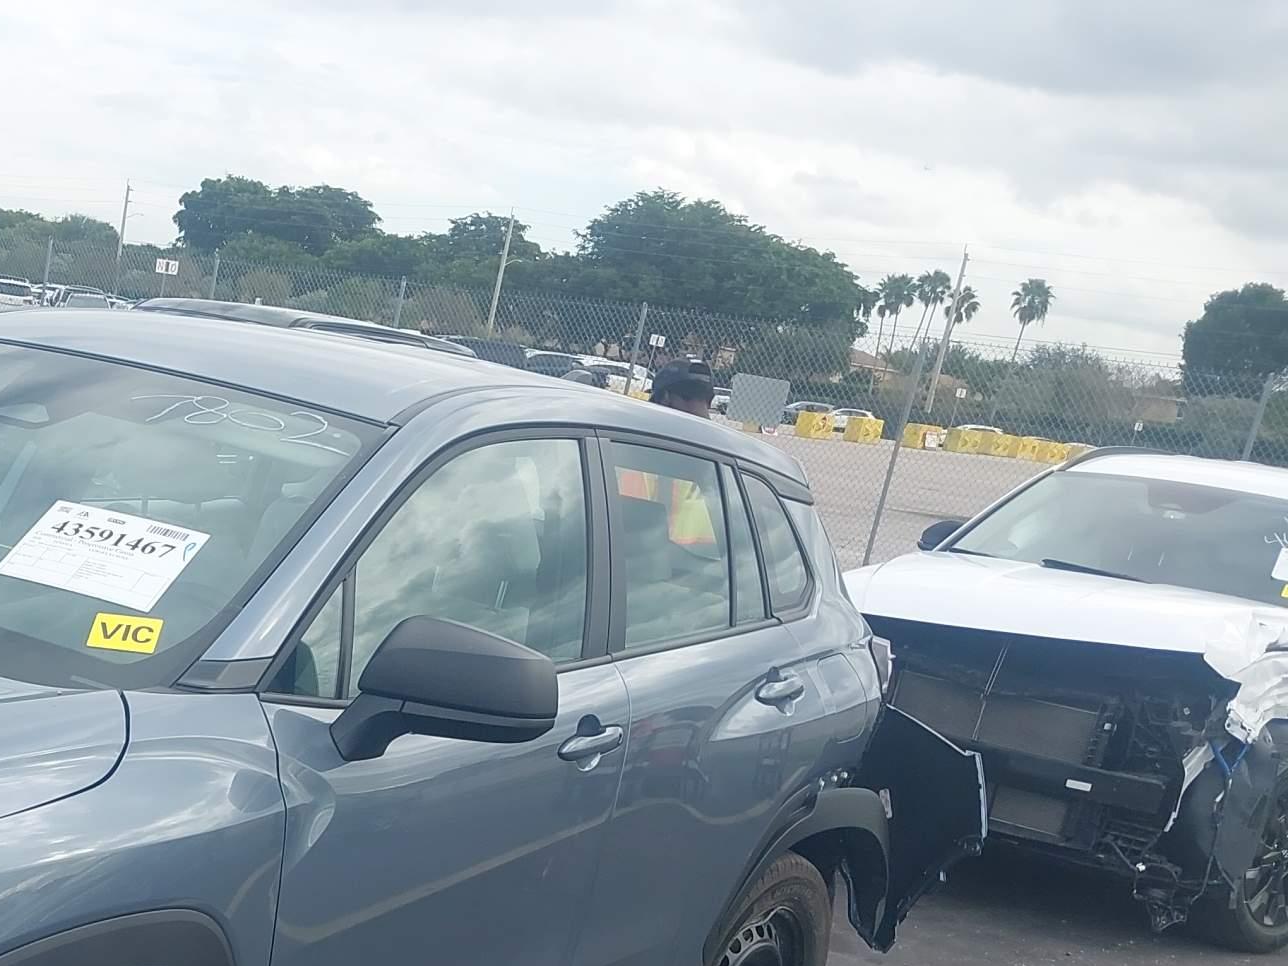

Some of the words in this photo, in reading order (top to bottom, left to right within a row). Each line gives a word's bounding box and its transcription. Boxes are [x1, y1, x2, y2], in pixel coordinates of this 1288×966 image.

[131, 394, 350, 456] 7802
[51, 520, 176, 558] 43591467
[100, 621, 154, 644] VIC
